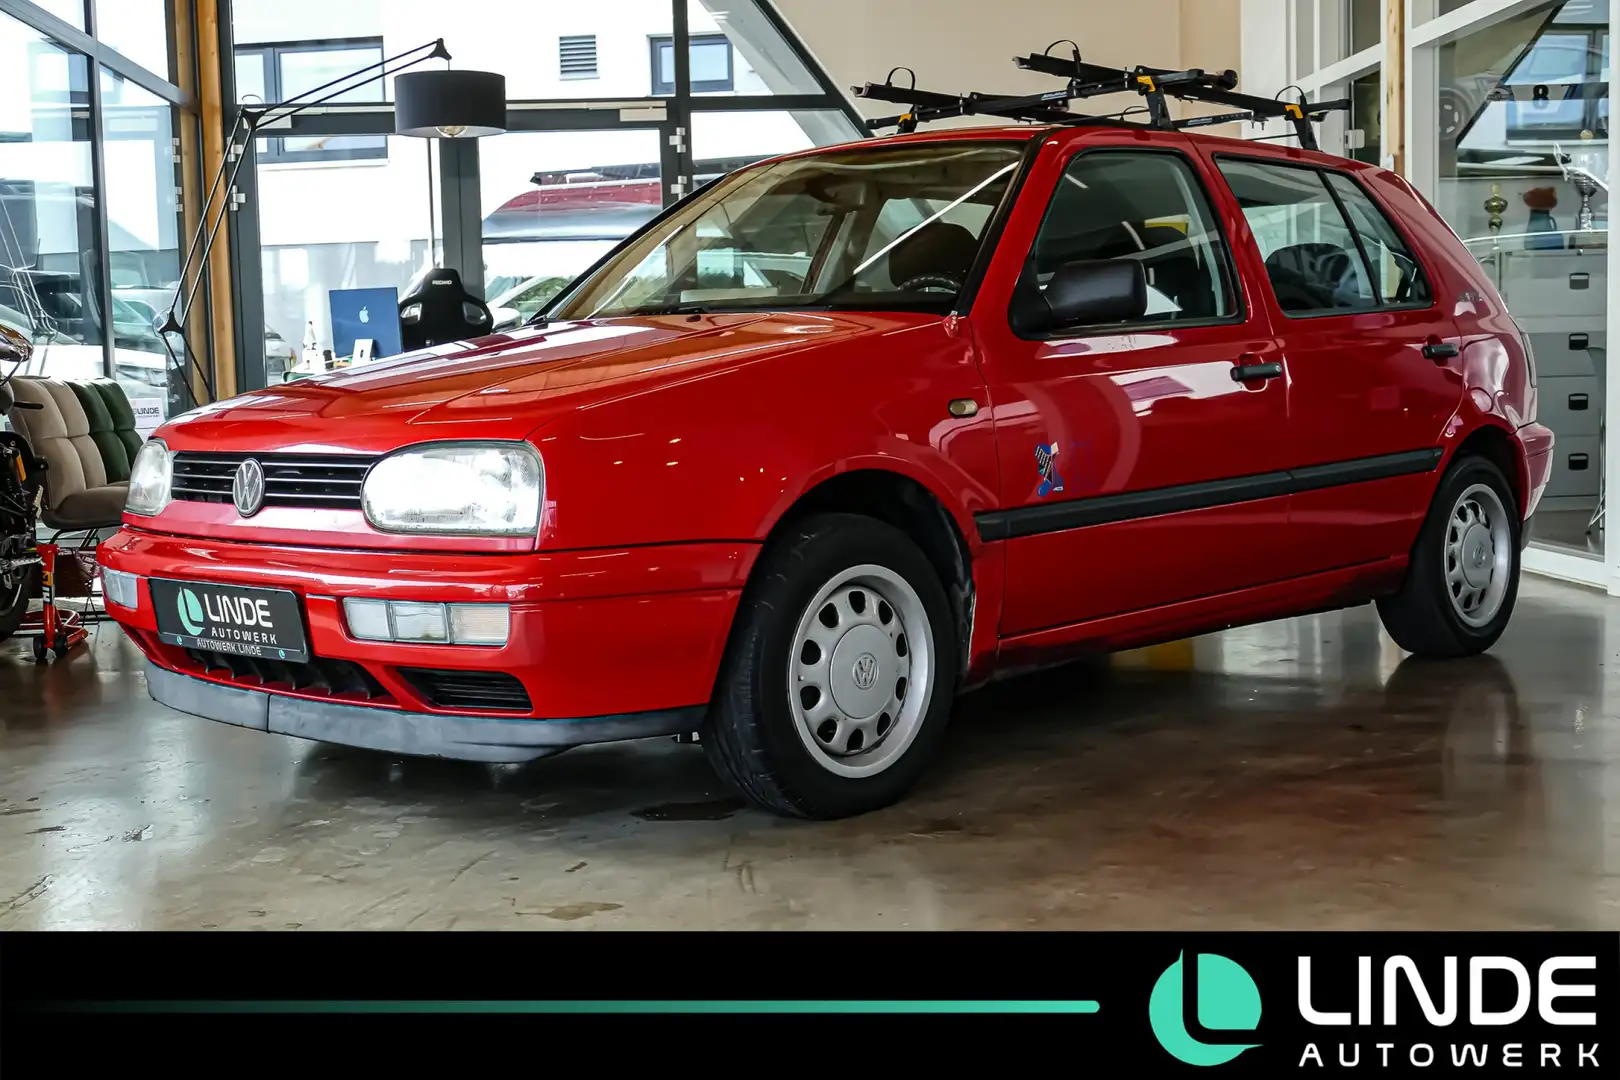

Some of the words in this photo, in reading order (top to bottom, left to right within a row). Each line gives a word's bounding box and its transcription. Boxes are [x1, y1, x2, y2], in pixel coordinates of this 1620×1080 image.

[204, 593, 273, 628] LINDE
[211, 627, 277, 644] AUTOWERK
[197, 638, 237, 653] AUTOWERK
[238, 644, 262, 656] LINDE
